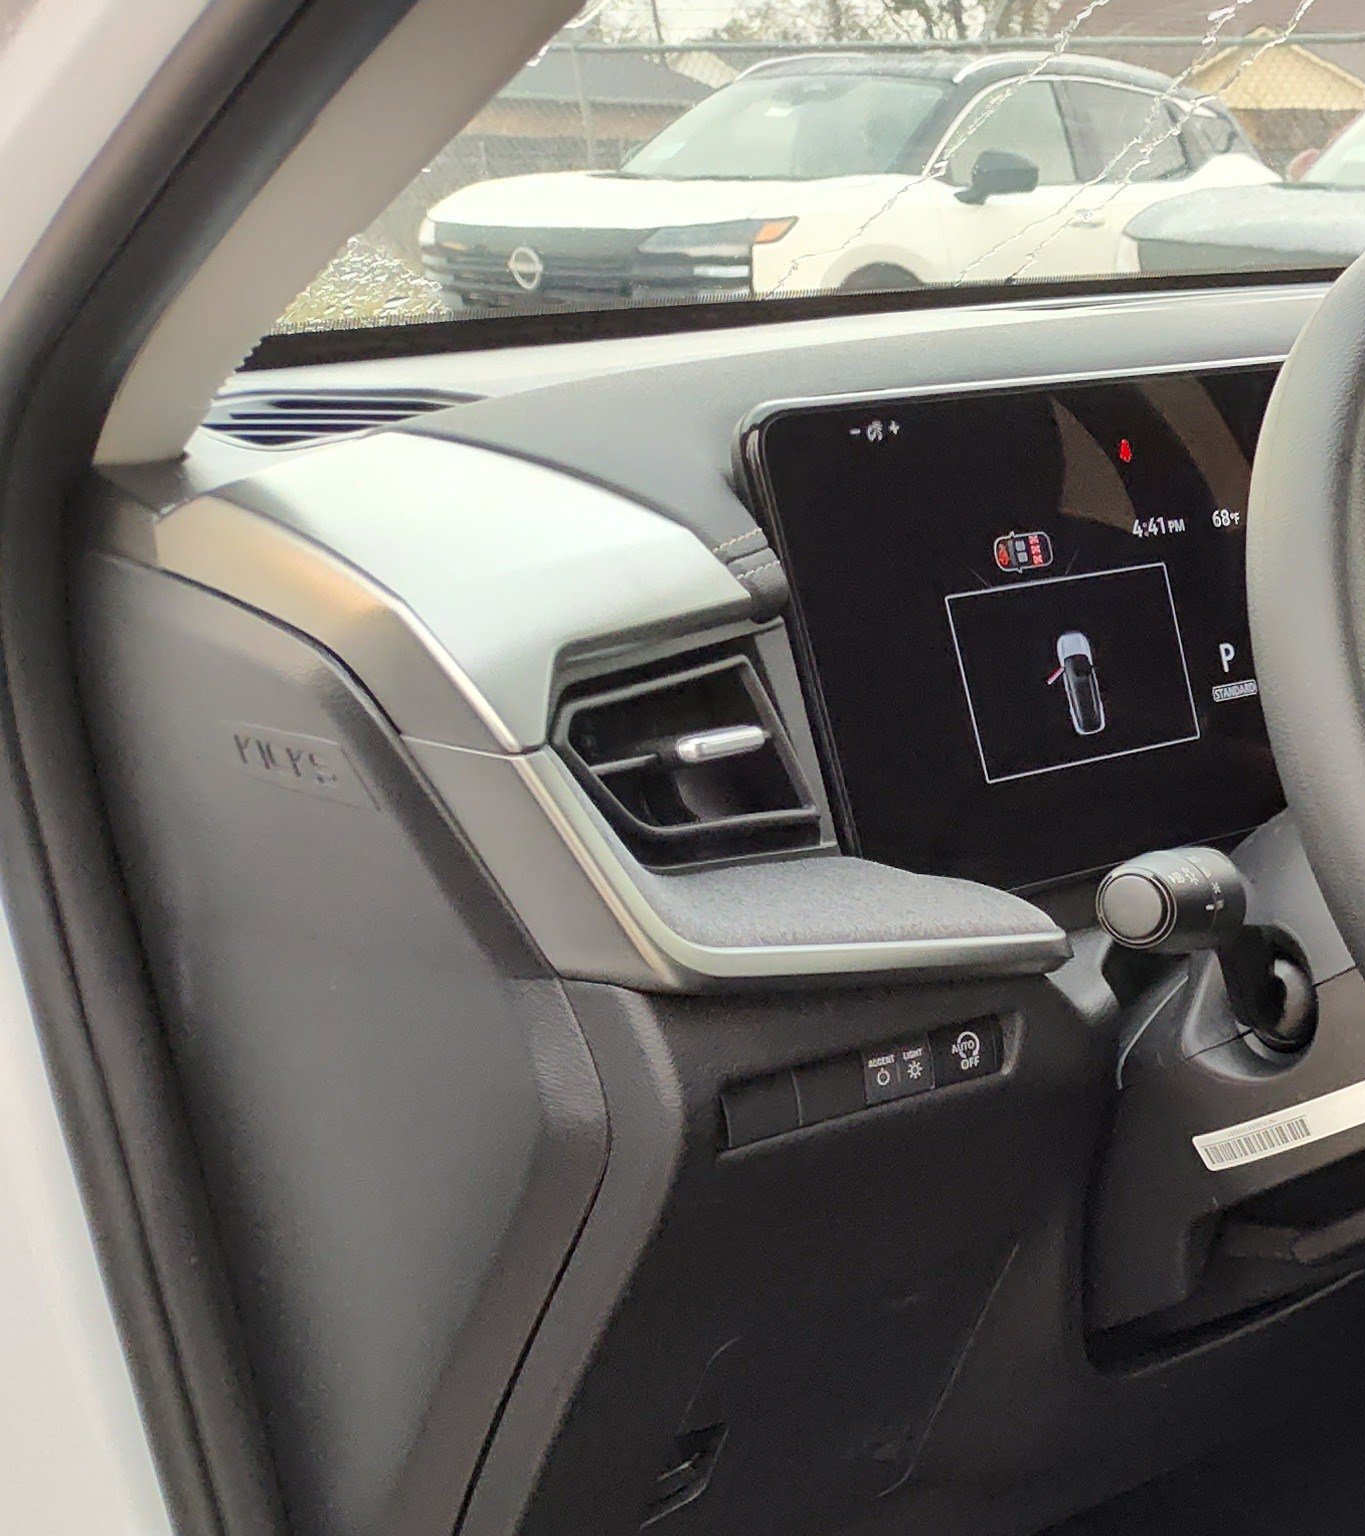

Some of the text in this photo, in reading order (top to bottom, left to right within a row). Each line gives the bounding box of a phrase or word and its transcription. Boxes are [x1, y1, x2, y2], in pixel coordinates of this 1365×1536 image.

[1132, 516, 1186, 538] 4:41 PM
[1219, 642, 1236, 673] P
[1213, 681, 1257, 701] STANDARD
[951, 1040, 975, 1055] AUTO
[961, 1056, 980, 1070] OFF
